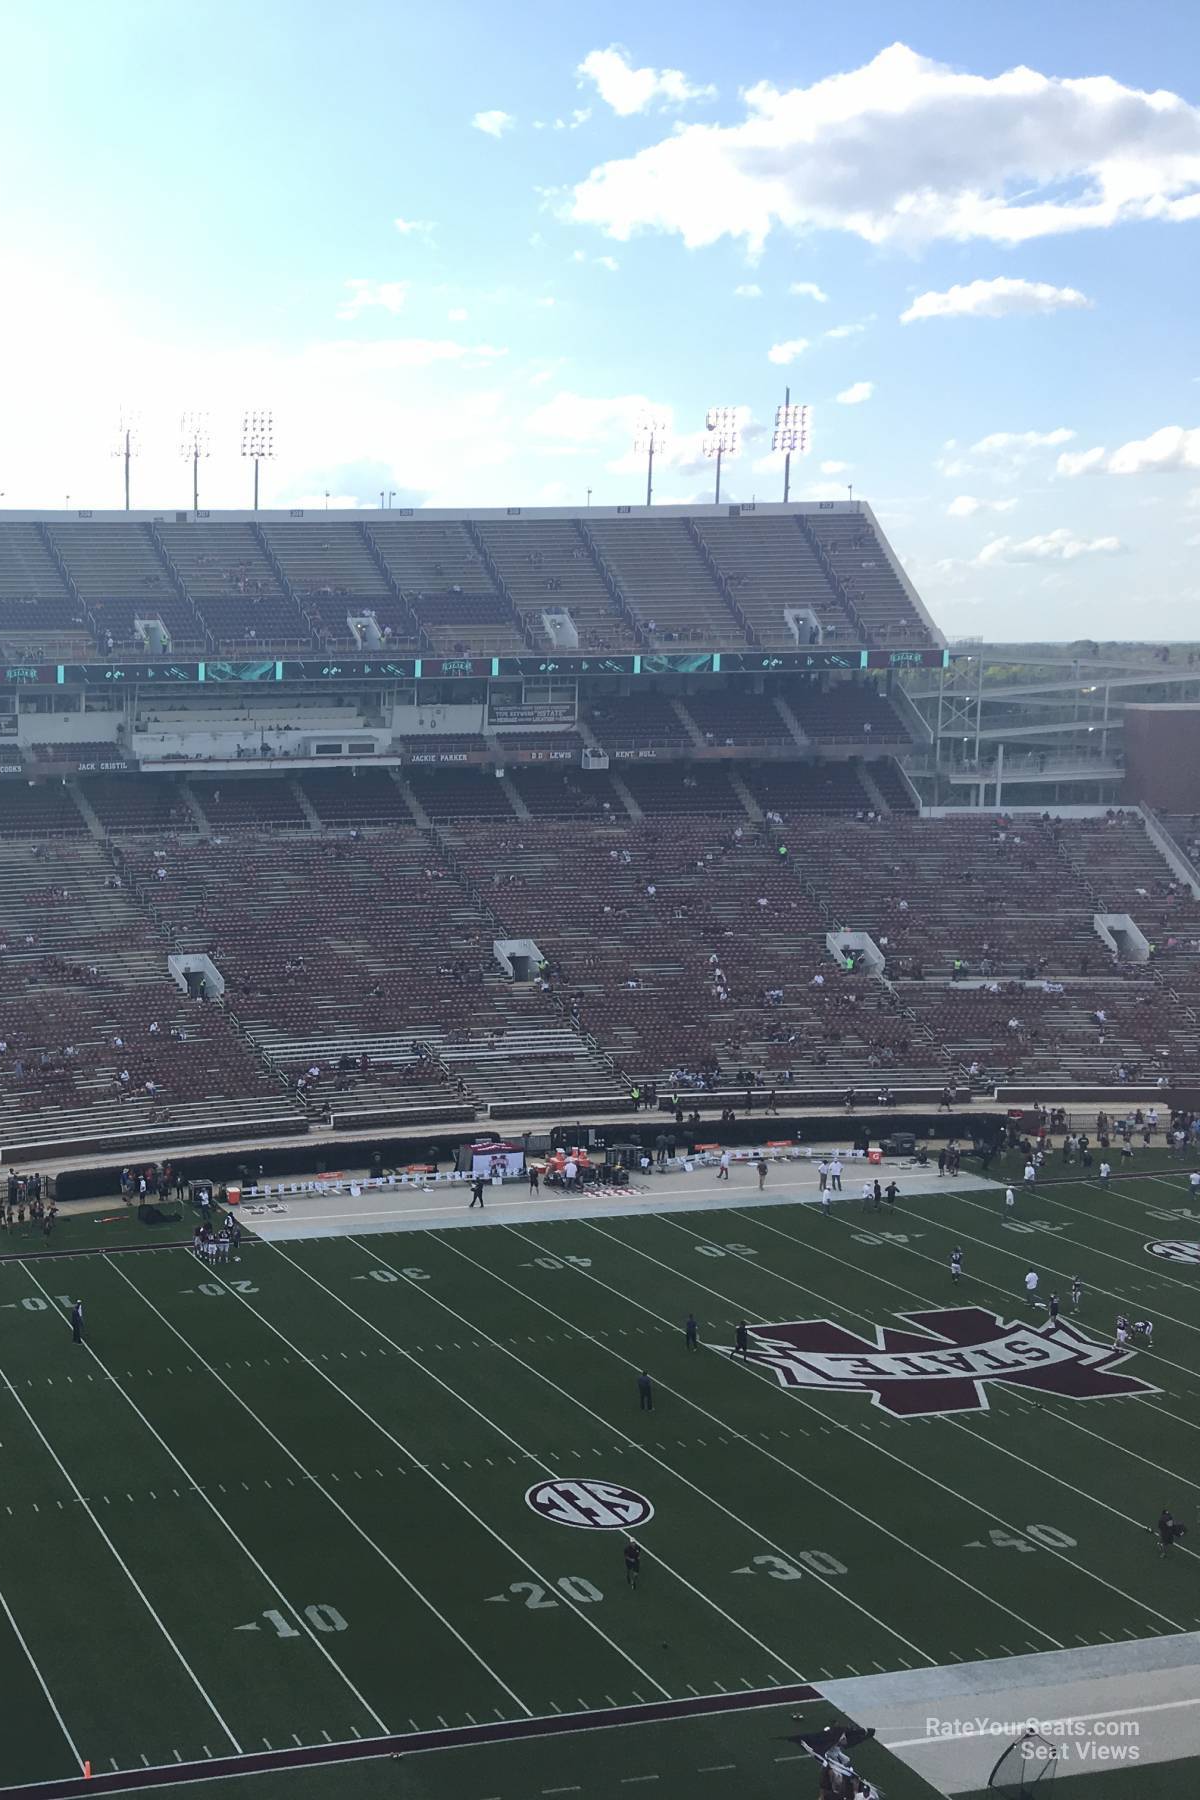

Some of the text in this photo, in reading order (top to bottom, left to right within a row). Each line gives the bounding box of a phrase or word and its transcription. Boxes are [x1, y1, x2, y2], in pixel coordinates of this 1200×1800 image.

[78, 762, 128, 770] JACK CRISTIL
[440, 754, 468, 762] PARKER
[1002, 1220, 1064, 1234] 30
[851, 1231, 910, 1246] 40
[694, 1242, 758, 1258] 50
[535, 1255, 593, 1270] 40
[369, 1267, 431, 1282] 30
[200, 1280, 259, 1296] 20
[830, 1338, 1051, 1376] STATE
[536, 1484, 648, 1526] SEC
[989, 1524, 1079, 1552] 40
[752, 1549, 849, 1581] 30
[505, 1576, 604, 1610] 20
[263, 1603, 350, 1639] 10
